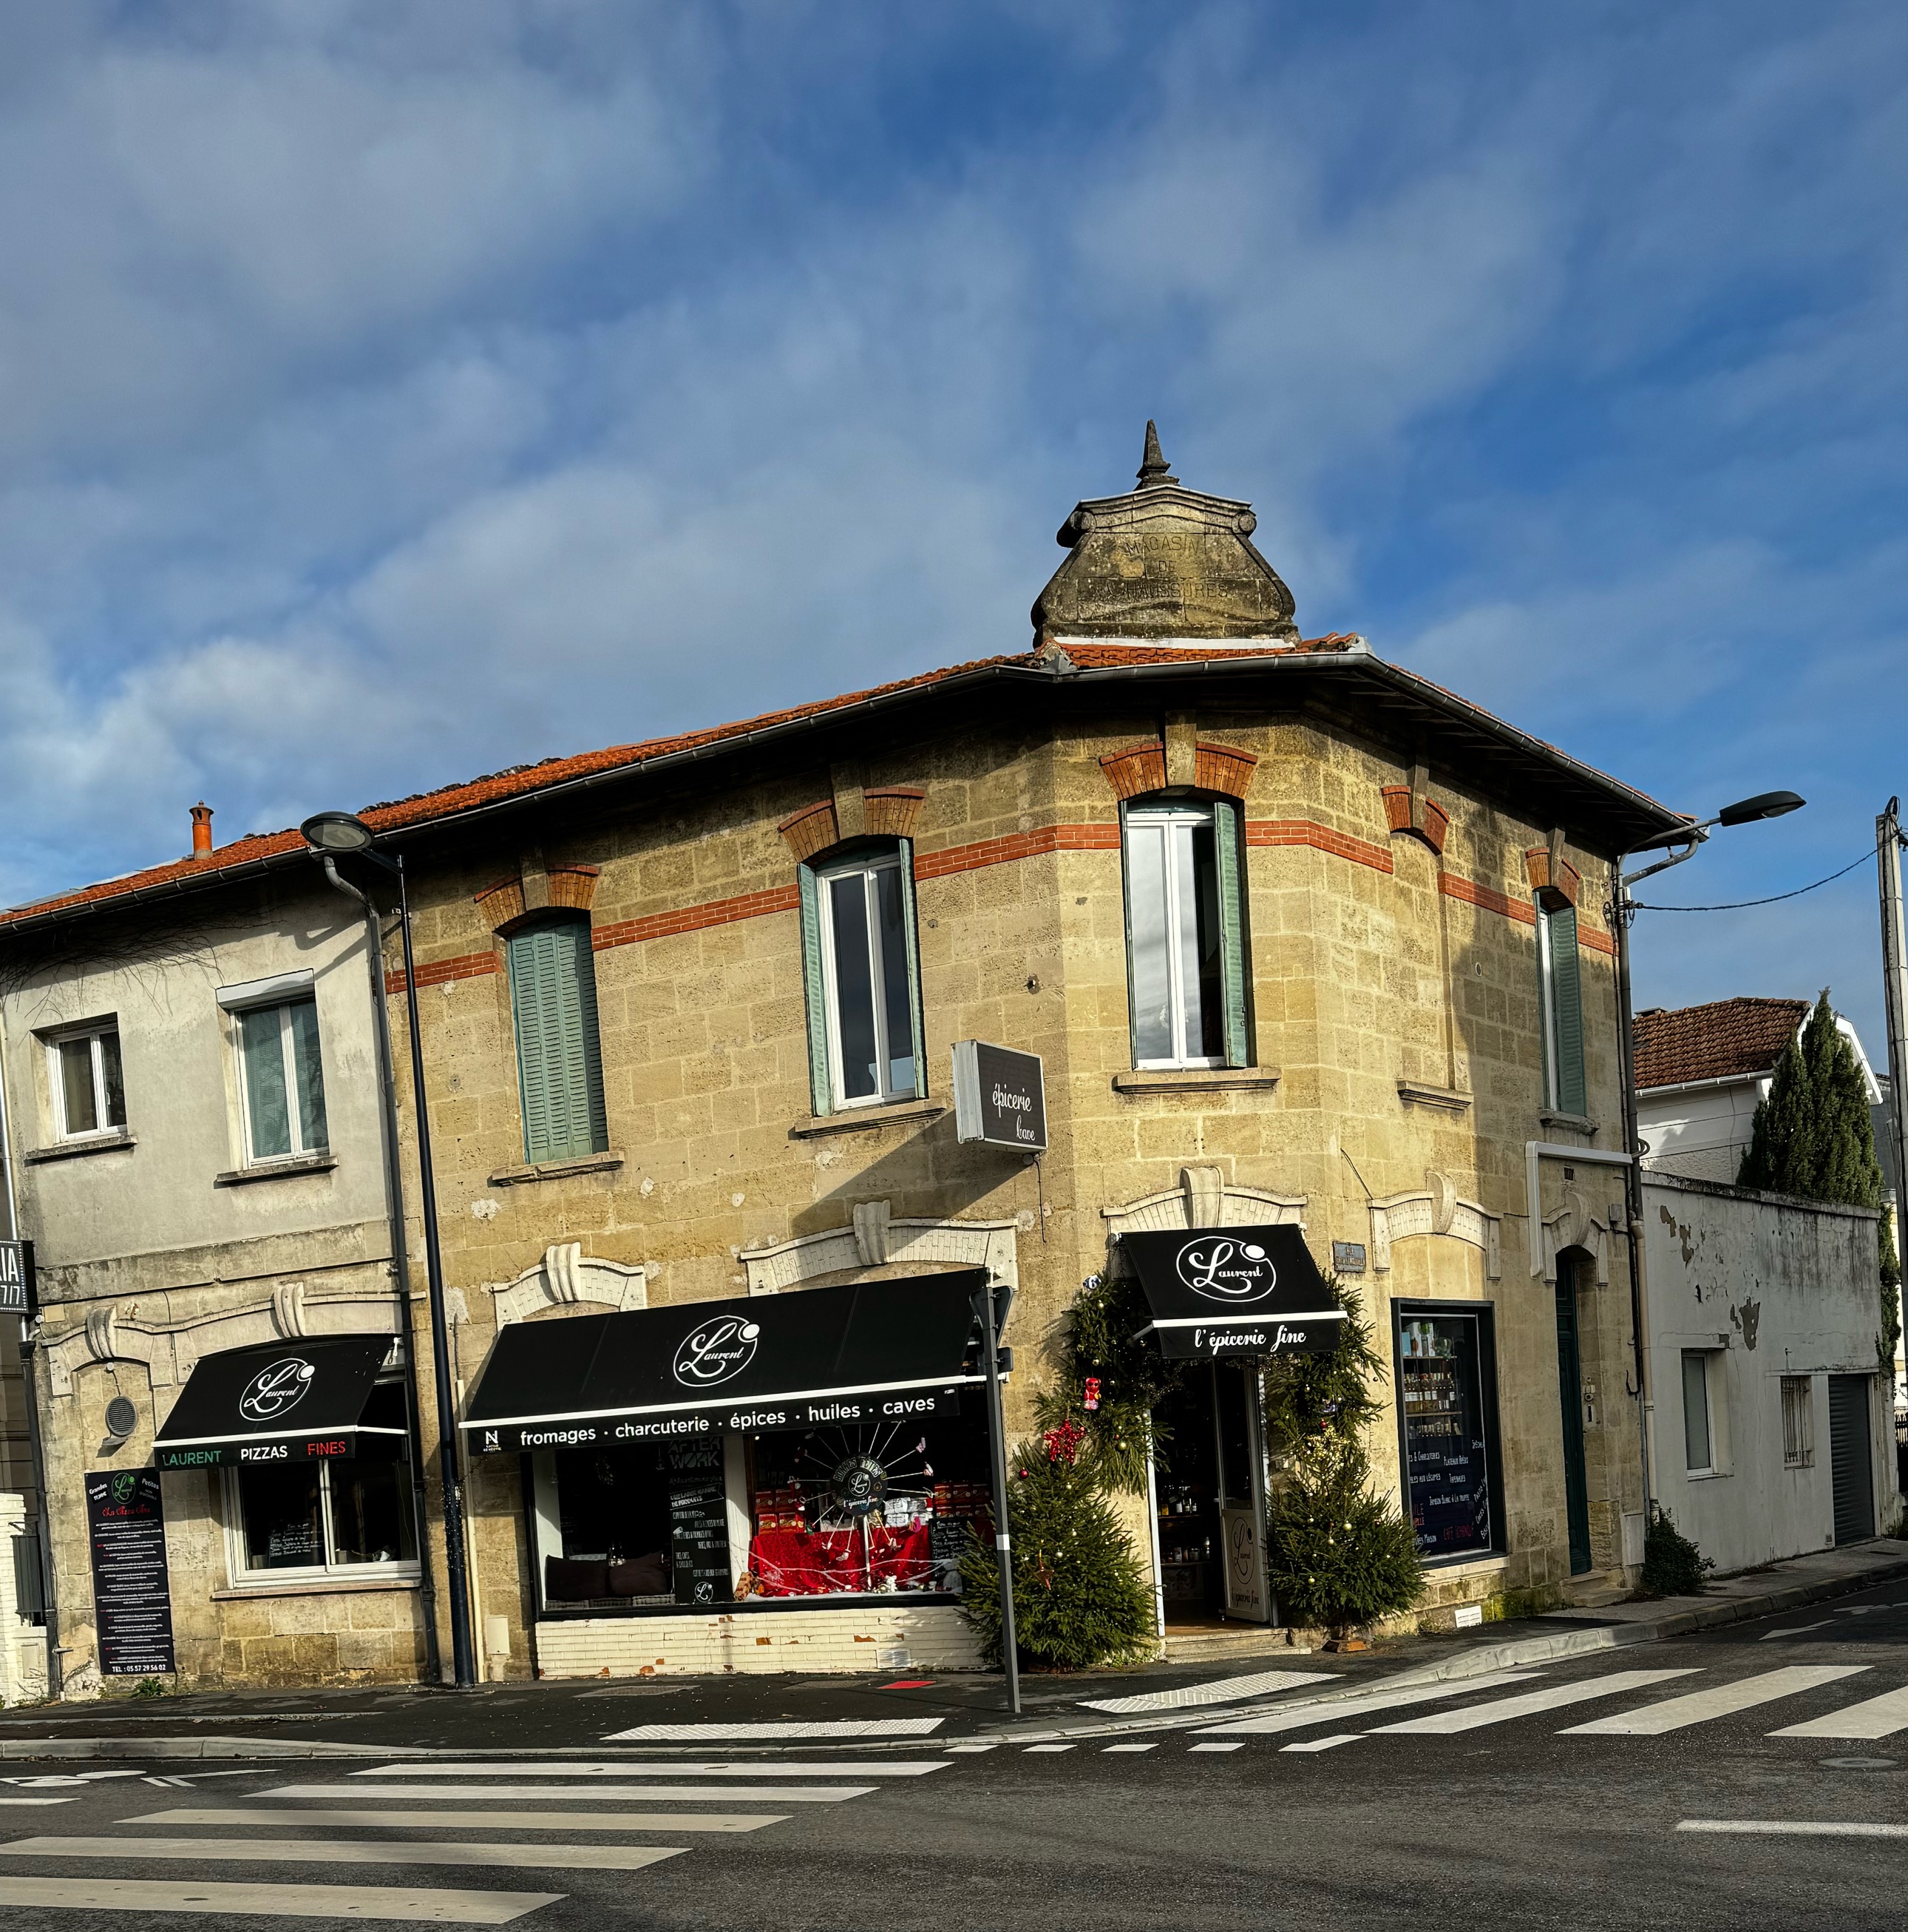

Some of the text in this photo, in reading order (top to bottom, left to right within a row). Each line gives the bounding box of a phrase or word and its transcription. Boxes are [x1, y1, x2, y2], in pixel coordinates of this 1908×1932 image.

[992, 1082, 1032, 1118] épicerie
[0, 1247, 19, 1281] IA
[1188, 1242, 1263, 1294] Laurent
[679, 1322, 744, 1377] Laurent
[1270, 1324, 1306, 1352] fine
[243, 1363, 300, 1413] Laurent
[520, 1397, 935, 1445] fromages charcuterie épices huiles caves
[162, 1441, 346, 1466] LAURENT PIZZAS FINES
[669, 1451, 720, 1469] WORK
